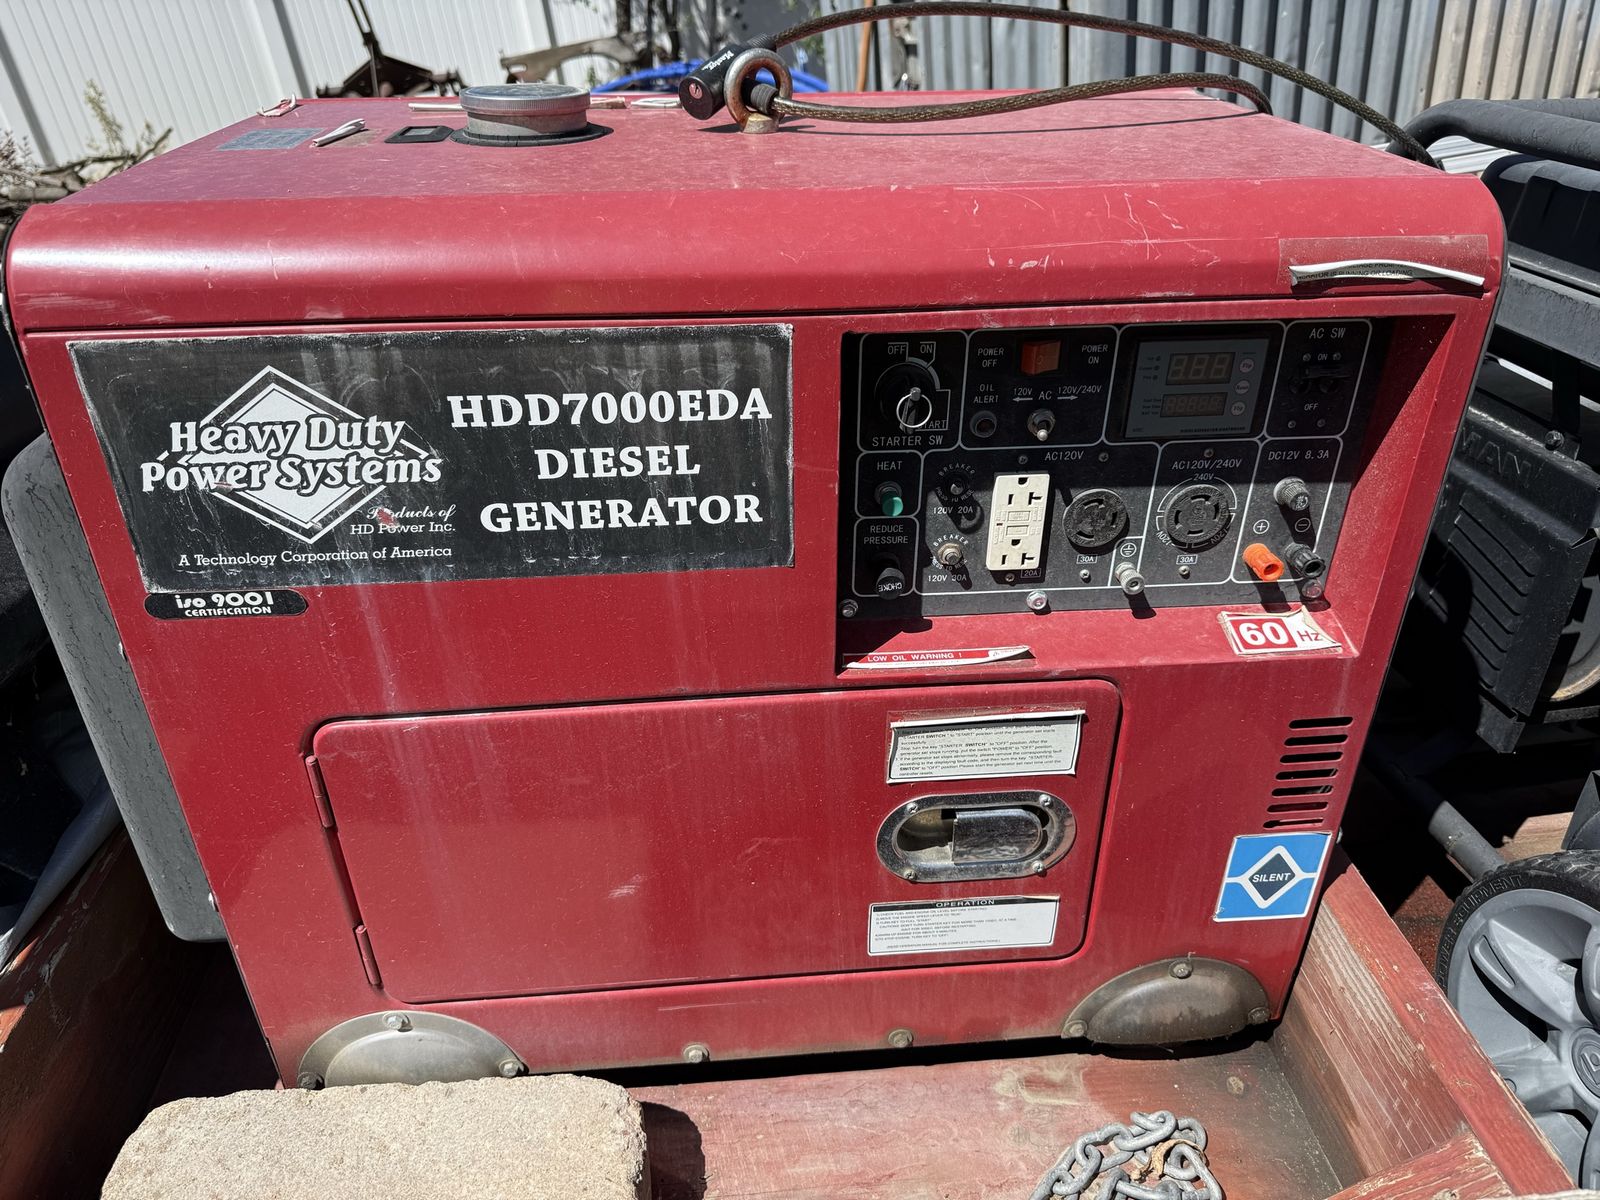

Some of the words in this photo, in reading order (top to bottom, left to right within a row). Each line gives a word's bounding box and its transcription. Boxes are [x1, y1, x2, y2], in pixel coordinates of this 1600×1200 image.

[1309, 328, 1324, 339] AC
[1330, 327, 1346, 338] SW
[887, 345, 905, 355] OFF
[920, 344, 932, 354] ON
[978, 348, 1004, 357] POWER
[1082, 344, 1108, 353] POWER
[1088, 356, 1099, 364] ON
[1317, 353, 1328, 361] ON
[982, 359, 997, 368] OFF
[980, 384, 994, 392] OIL
[1013, 387, 1033, 396] 120V
[1038, 391, 1052, 400] AC
[1058, 385, 1102, 394] 120V/240V
[974, 395, 999, 404] ALERT
[447, 387, 772, 428] HDD7000EDA
[1304, 403, 1319, 411] OFF
[170, 420, 299, 457] Heavy
[310, 415, 405, 453] Duty
[872, 436, 922, 447] STARTER
[928, 435, 943, 445] SW
[1045, 451, 1084, 461] AC120V
[1268, 451, 1300, 460] DC12V
[1305, 450, 1330, 460] 8.3A
[534, 445, 701, 480] DIESEL
[877, 461, 902, 471] HEAT
[1172, 459, 1242, 470] AC120V/240V
[938, 462, 975, 476] BREAKER
[140, 460, 268, 493] Power
[277, 456, 441, 493] Systems
[1193, 473, 1214, 481] 240V
[480, 494, 763, 533] GENERATOR
[933, 506, 953, 514] 120V
[958, 506, 974, 514] 20A
[351, 524, 373, 535] HD
[378, 523, 424, 534] Power
[430, 521, 456, 533] Inc.
[870, 525, 904, 533] REDUCE
[864, 536, 908, 544] PRESSURE
[933, 534, 968, 547] BREAKER
[178, 555, 190, 567] A
[194, 553, 276, 567] Technology
[281, 550, 368, 565] Corporation
[373, 547, 388, 559] of
[390, 546, 452, 558] America
[928, 574, 947, 582] 120V
[952, 574, 967, 582] 30A
[879, 583, 902, 592] CHOKE
[211, 591, 274, 606] 9001
[185, 606, 271, 618] CERTIFICATION
[1239, 622, 1289, 645] 60
[1298, 631, 1322, 642] Hz
[911, 653, 954, 661] WARNING
[1252, 873, 1291, 883] SILENT
[936, 899, 995, 908] OPERATION
